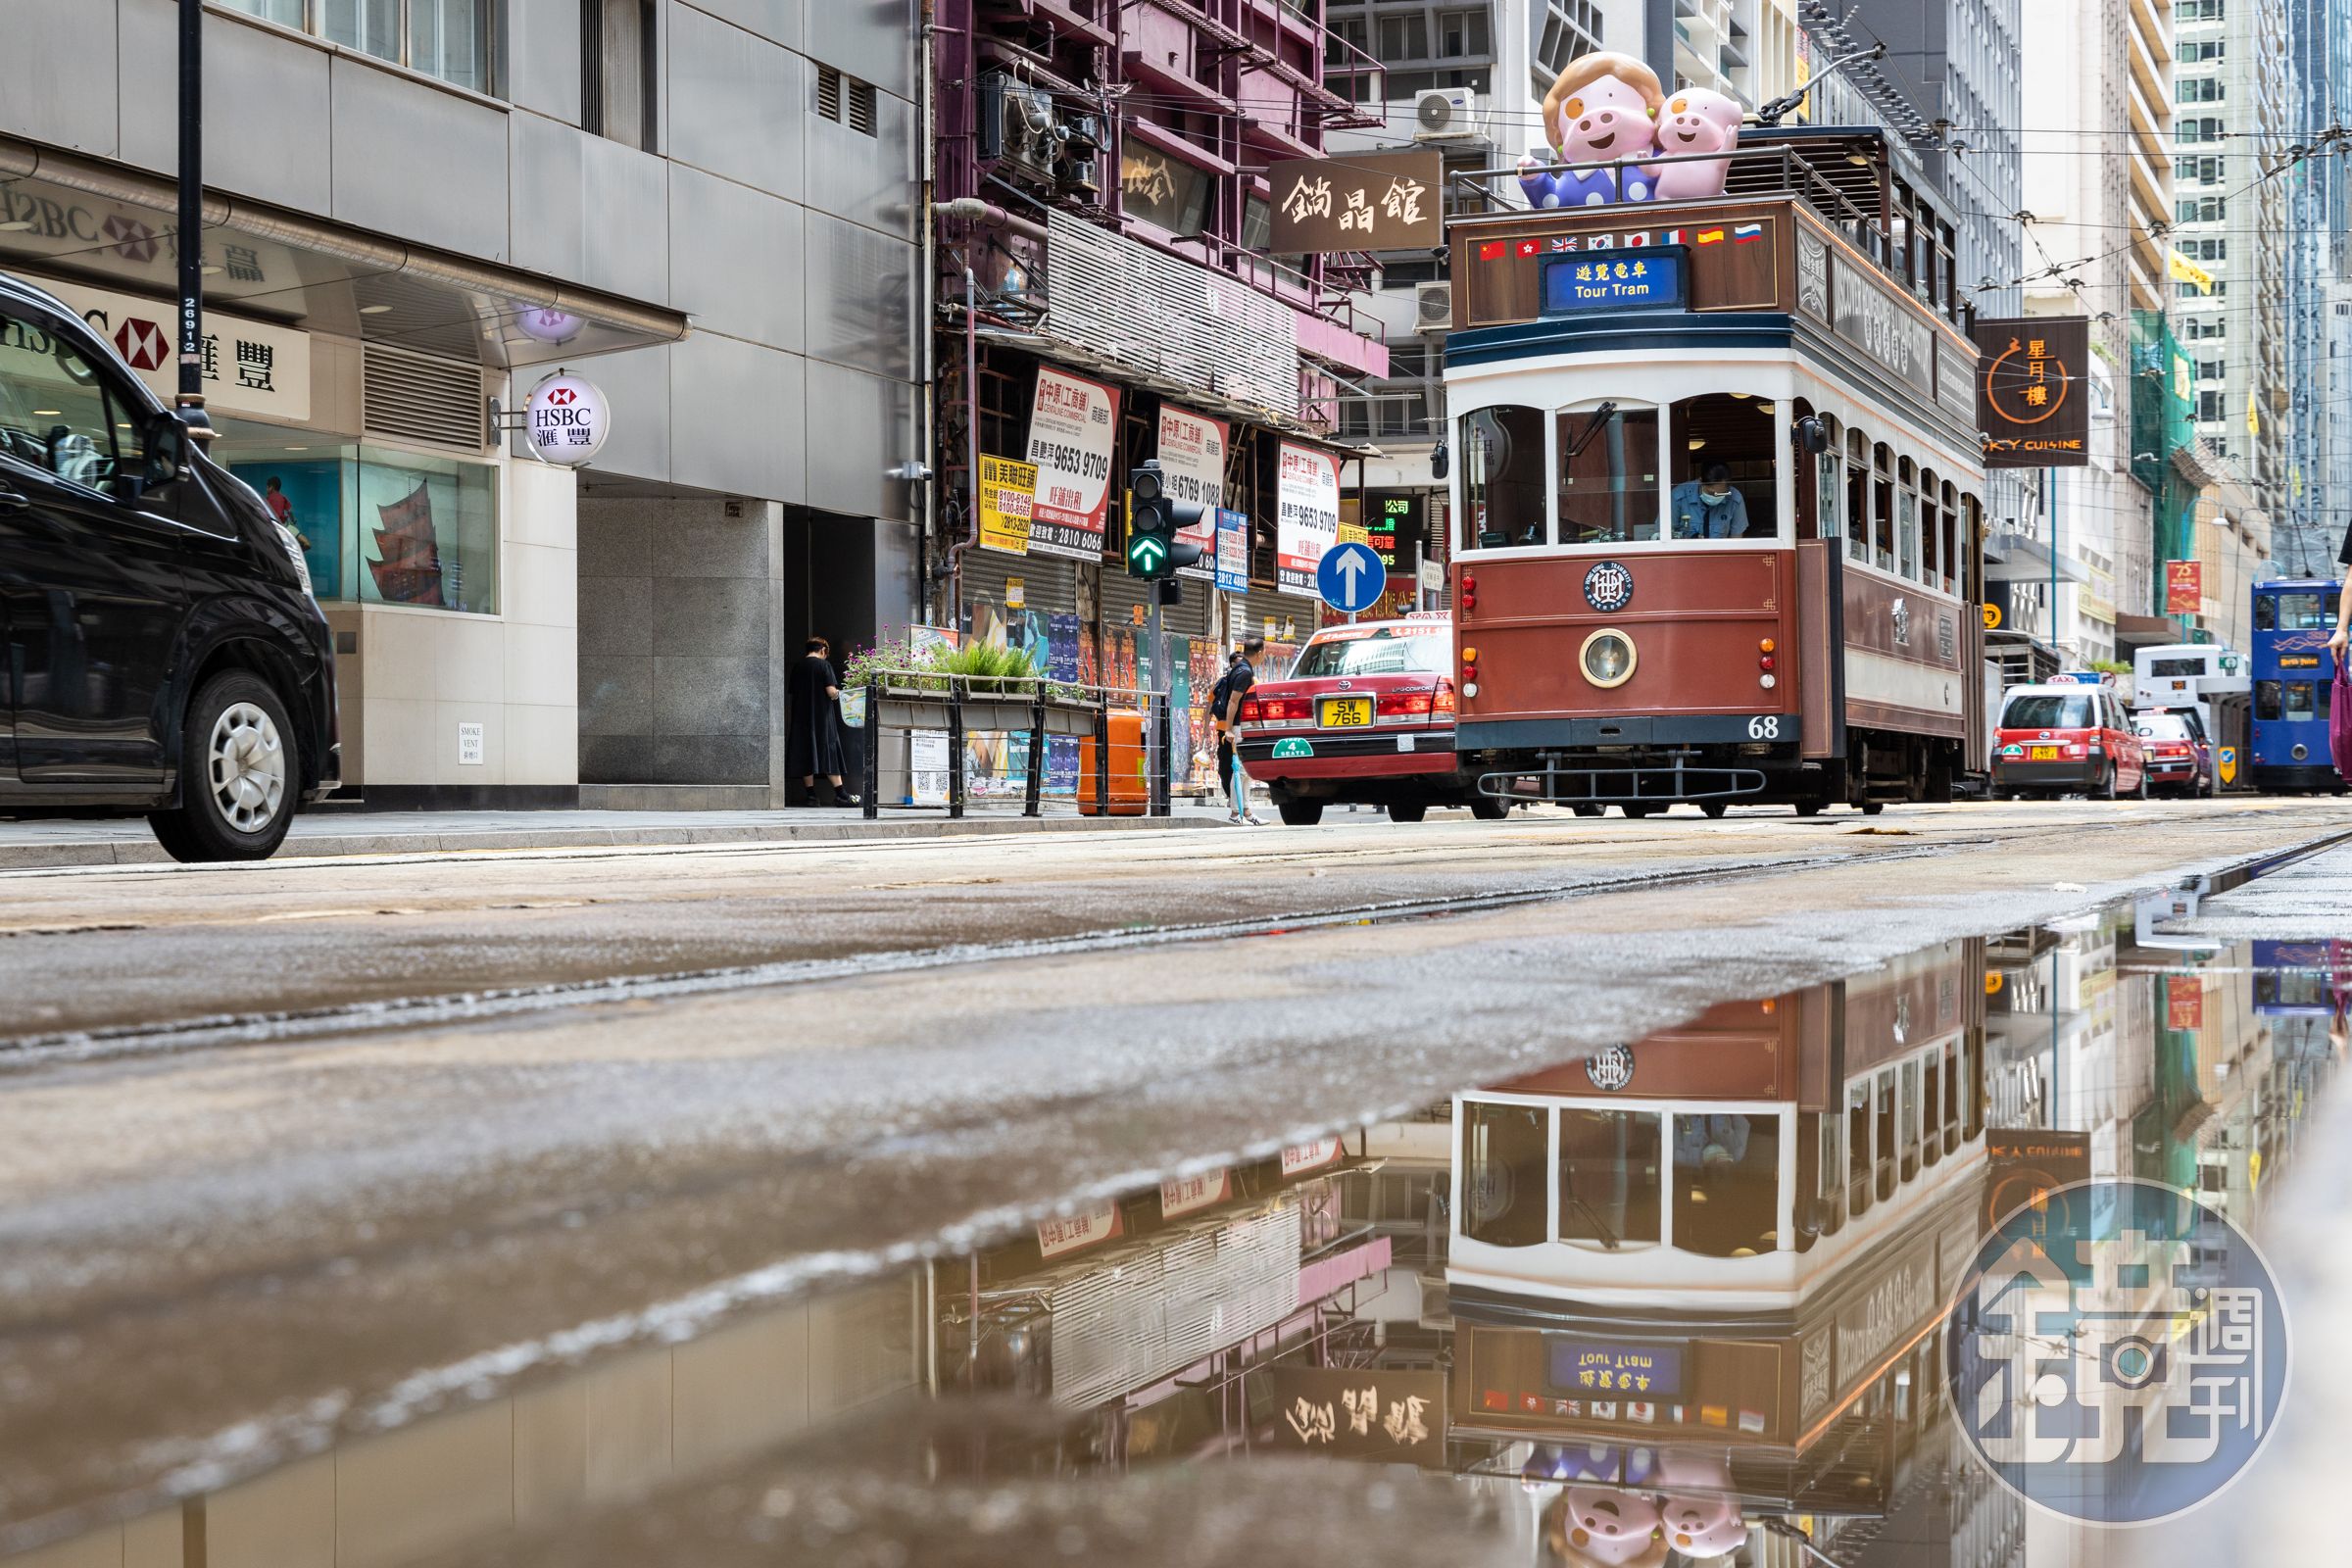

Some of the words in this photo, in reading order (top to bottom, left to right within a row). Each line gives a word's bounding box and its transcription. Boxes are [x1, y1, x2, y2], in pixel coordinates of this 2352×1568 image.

[1576, 261, 1647, 281] 遊覽電車
[1575, 285, 1607, 299] Tour
[1612, 283, 1648, 296] Tram
[185, 298, 195, 352] 26912
[2026, 340, 2055, 406] 星月樓
[535, 408, 591, 427] HSBC
[2025, 440, 2082, 450] CUISINE
[1054, 444, 1081, 475] 9653
[1083, 451, 1108, 481] 9709
[999, 489, 1032, 507] 8100-6148
[1178, 474, 1200, 503] 6769
[1201, 480, 1220, 508] 1088
[998, 501, 1030, 517] 8100-8565
[1298, 505, 1318, 529] 9653
[1319, 511, 1336, 534] 9709
[1057, 527, 1080, 546] 2810
[1081, 532, 1102, 551] 6066
[1218, 571, 1232, 585] 2812
[1585, 571, 1593, 584] HONG
[1592, 564, 1604, 573] KONG
[1610, 563, 1632, 582] TRAMWAYS
[1337, 701, 1356, 712] SW
[1332, 712, 1361, 725] 766
[1748, 716, 1779, 739] 68
[1288, 742, 1298, 752] 4
